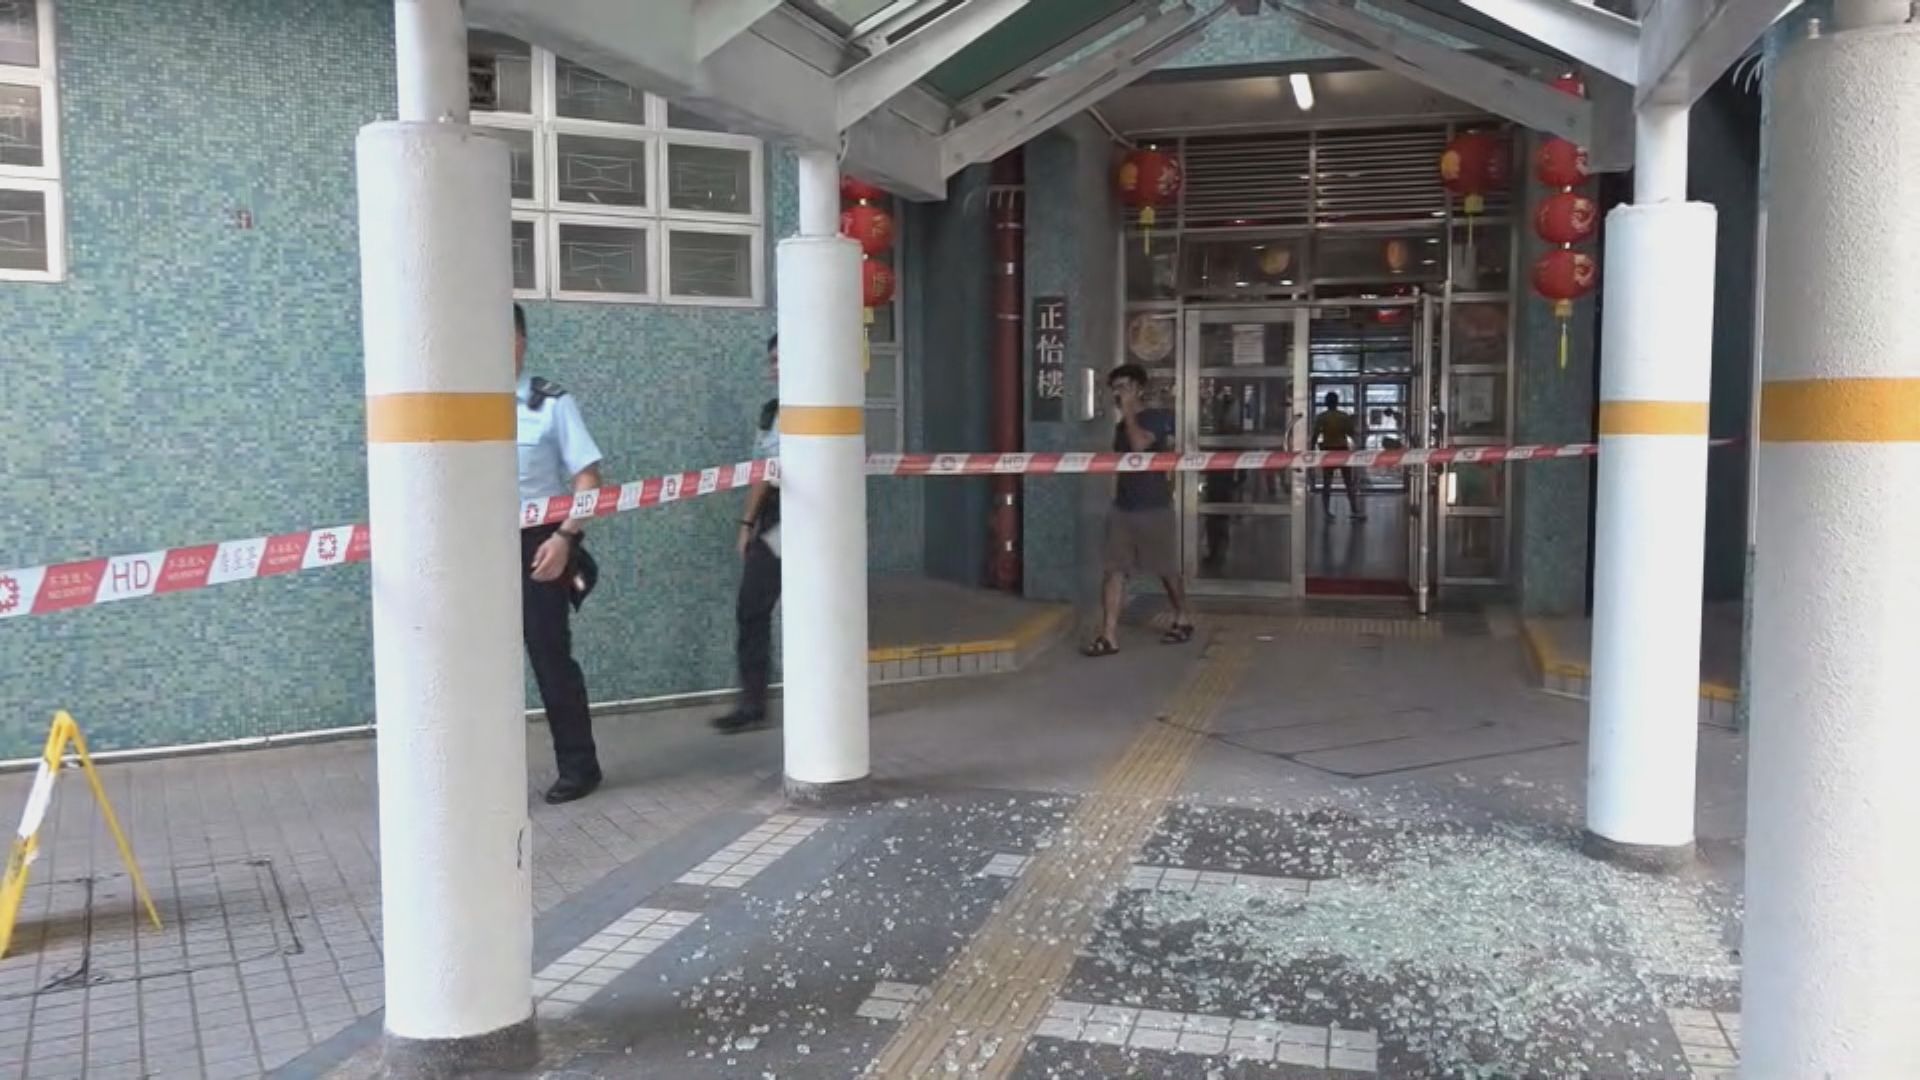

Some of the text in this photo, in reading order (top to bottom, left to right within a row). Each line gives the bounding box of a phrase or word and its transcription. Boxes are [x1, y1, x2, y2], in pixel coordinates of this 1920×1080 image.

[1036, 302, 1064, 400] 正怡樓
[575, 494, 594, 515] HD
[112, 560, 150, 592] HD
